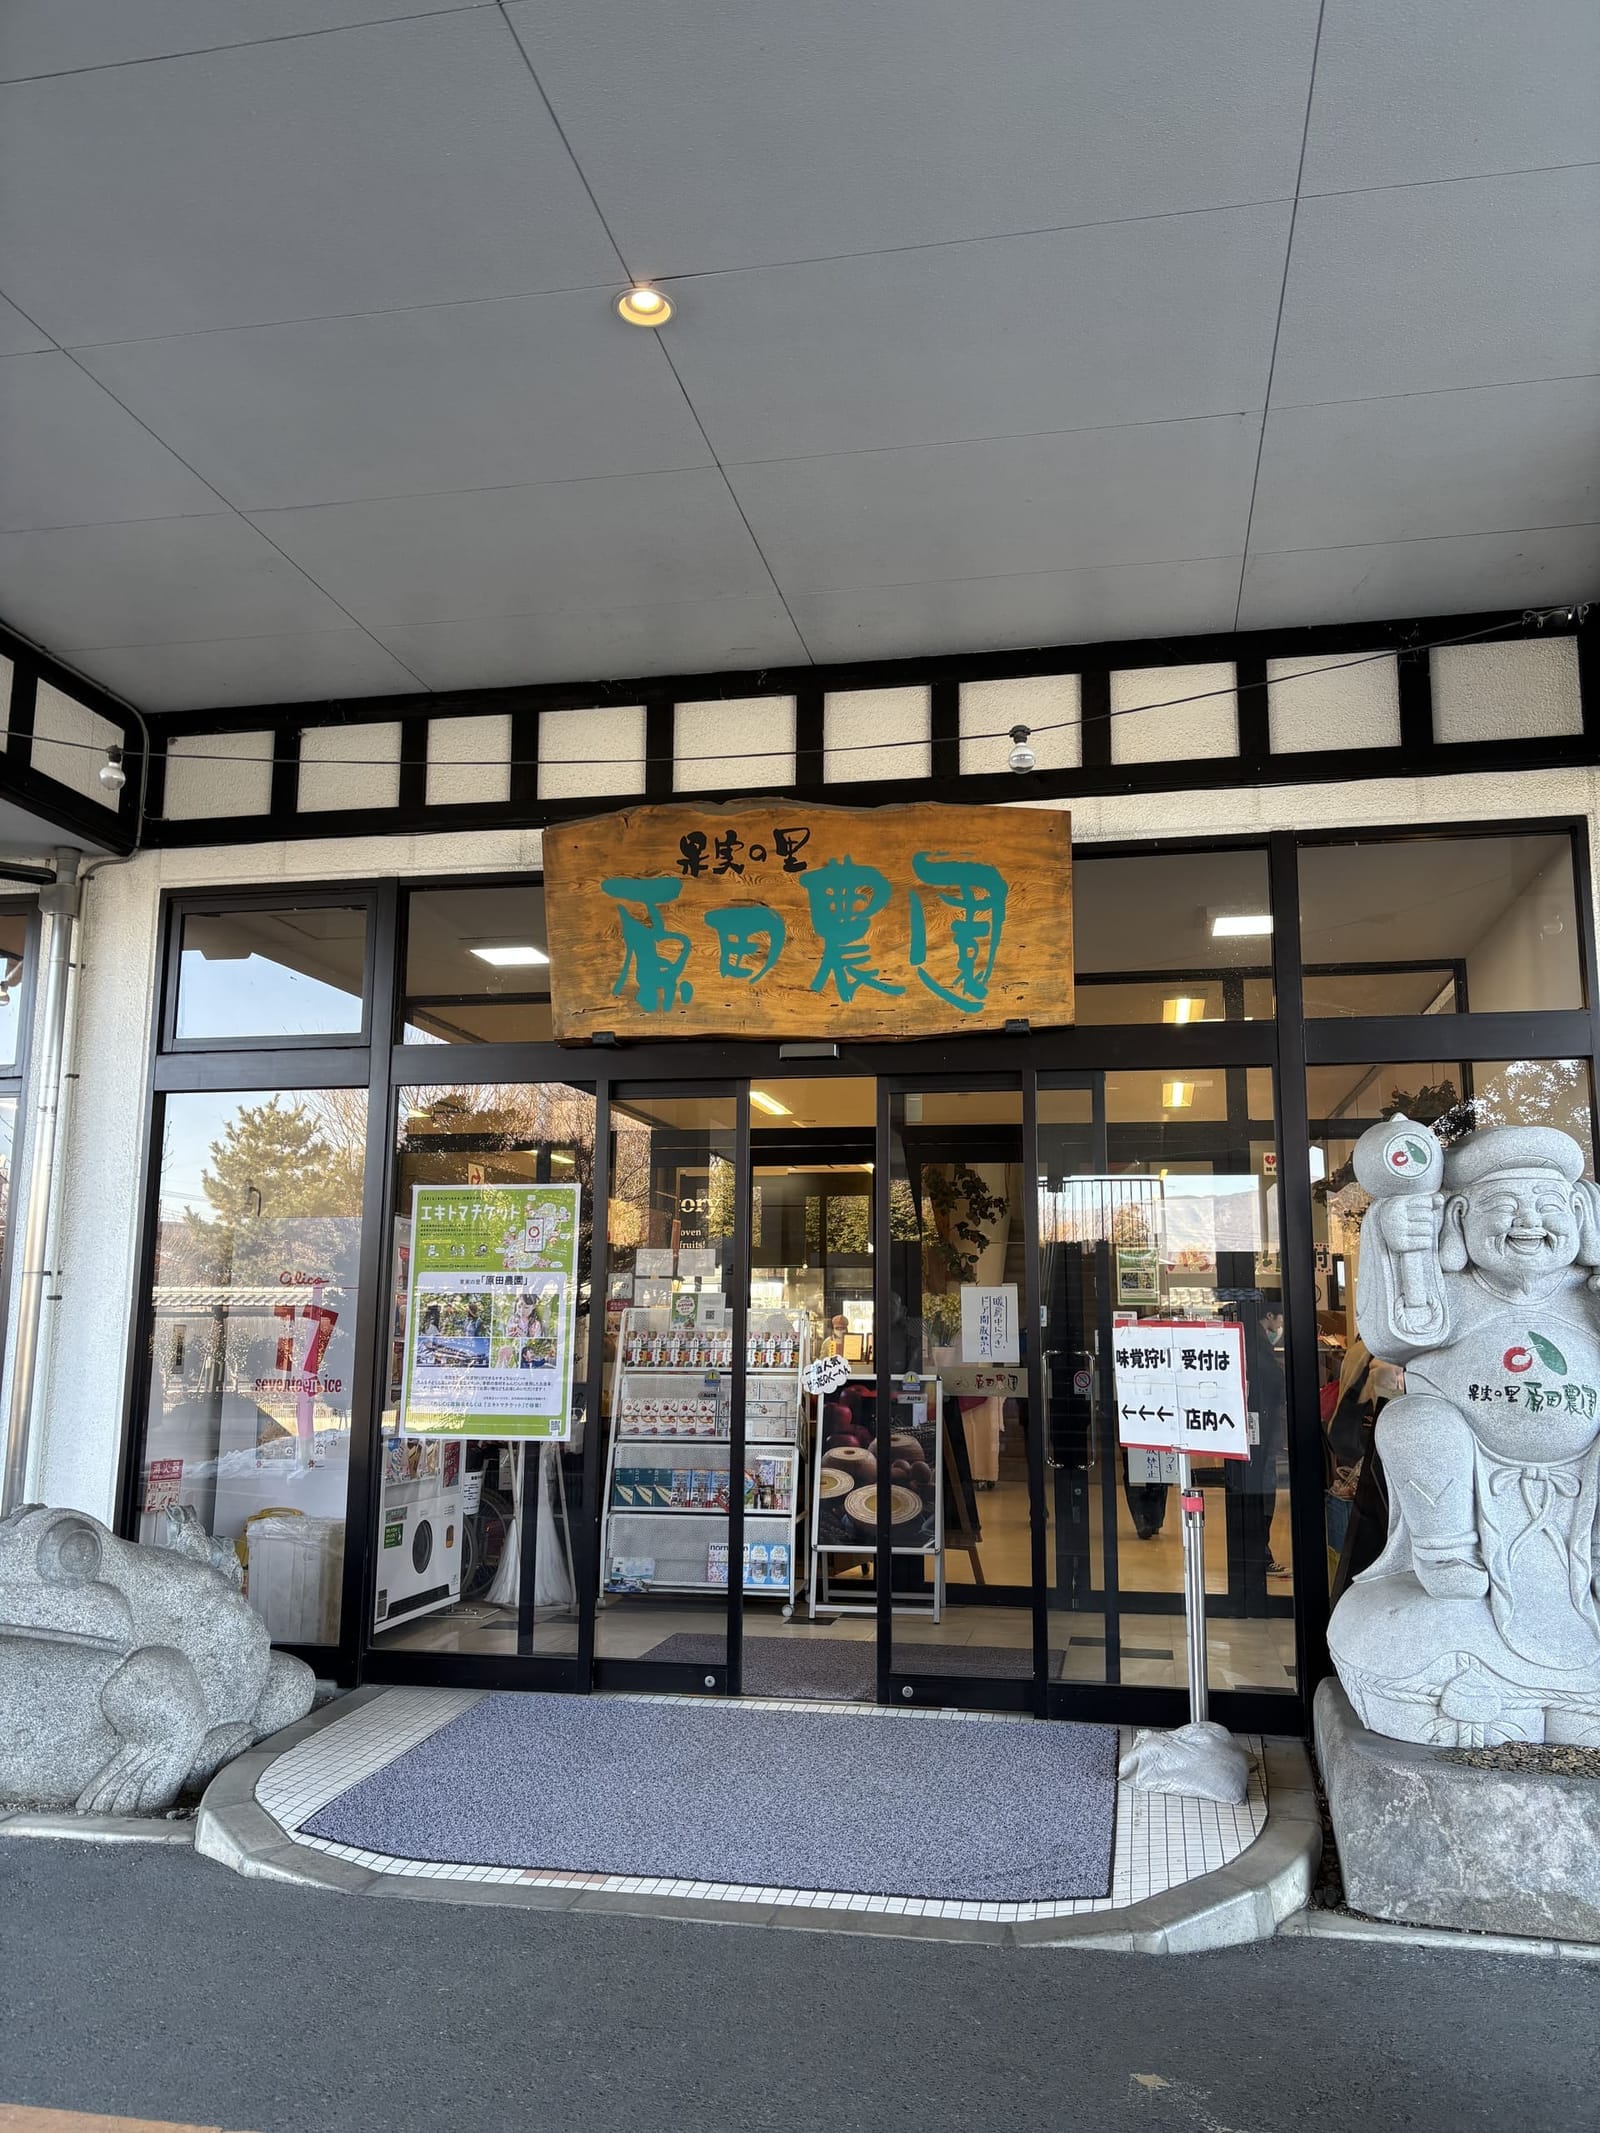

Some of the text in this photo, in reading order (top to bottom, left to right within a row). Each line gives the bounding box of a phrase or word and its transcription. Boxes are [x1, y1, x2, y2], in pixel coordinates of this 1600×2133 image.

[676, 826, 810, 876] 果実の里
[600, 852, 1009, 1014] 原田農園
[420, 1203, 521, 1221] エキトマチケット
[279, 1271, 329, 1285] Glico
[273, 1303, 340, 1375] 17
[1115, 1347, 1230, 1371] 味覚狩り 受付は
[255, 1373, 342, 1393] seventeen ice
[1468, 1381, 1597, 1420] 果実の里 原田農園
[1184, 1408, 1235, 1431] 店内へ
